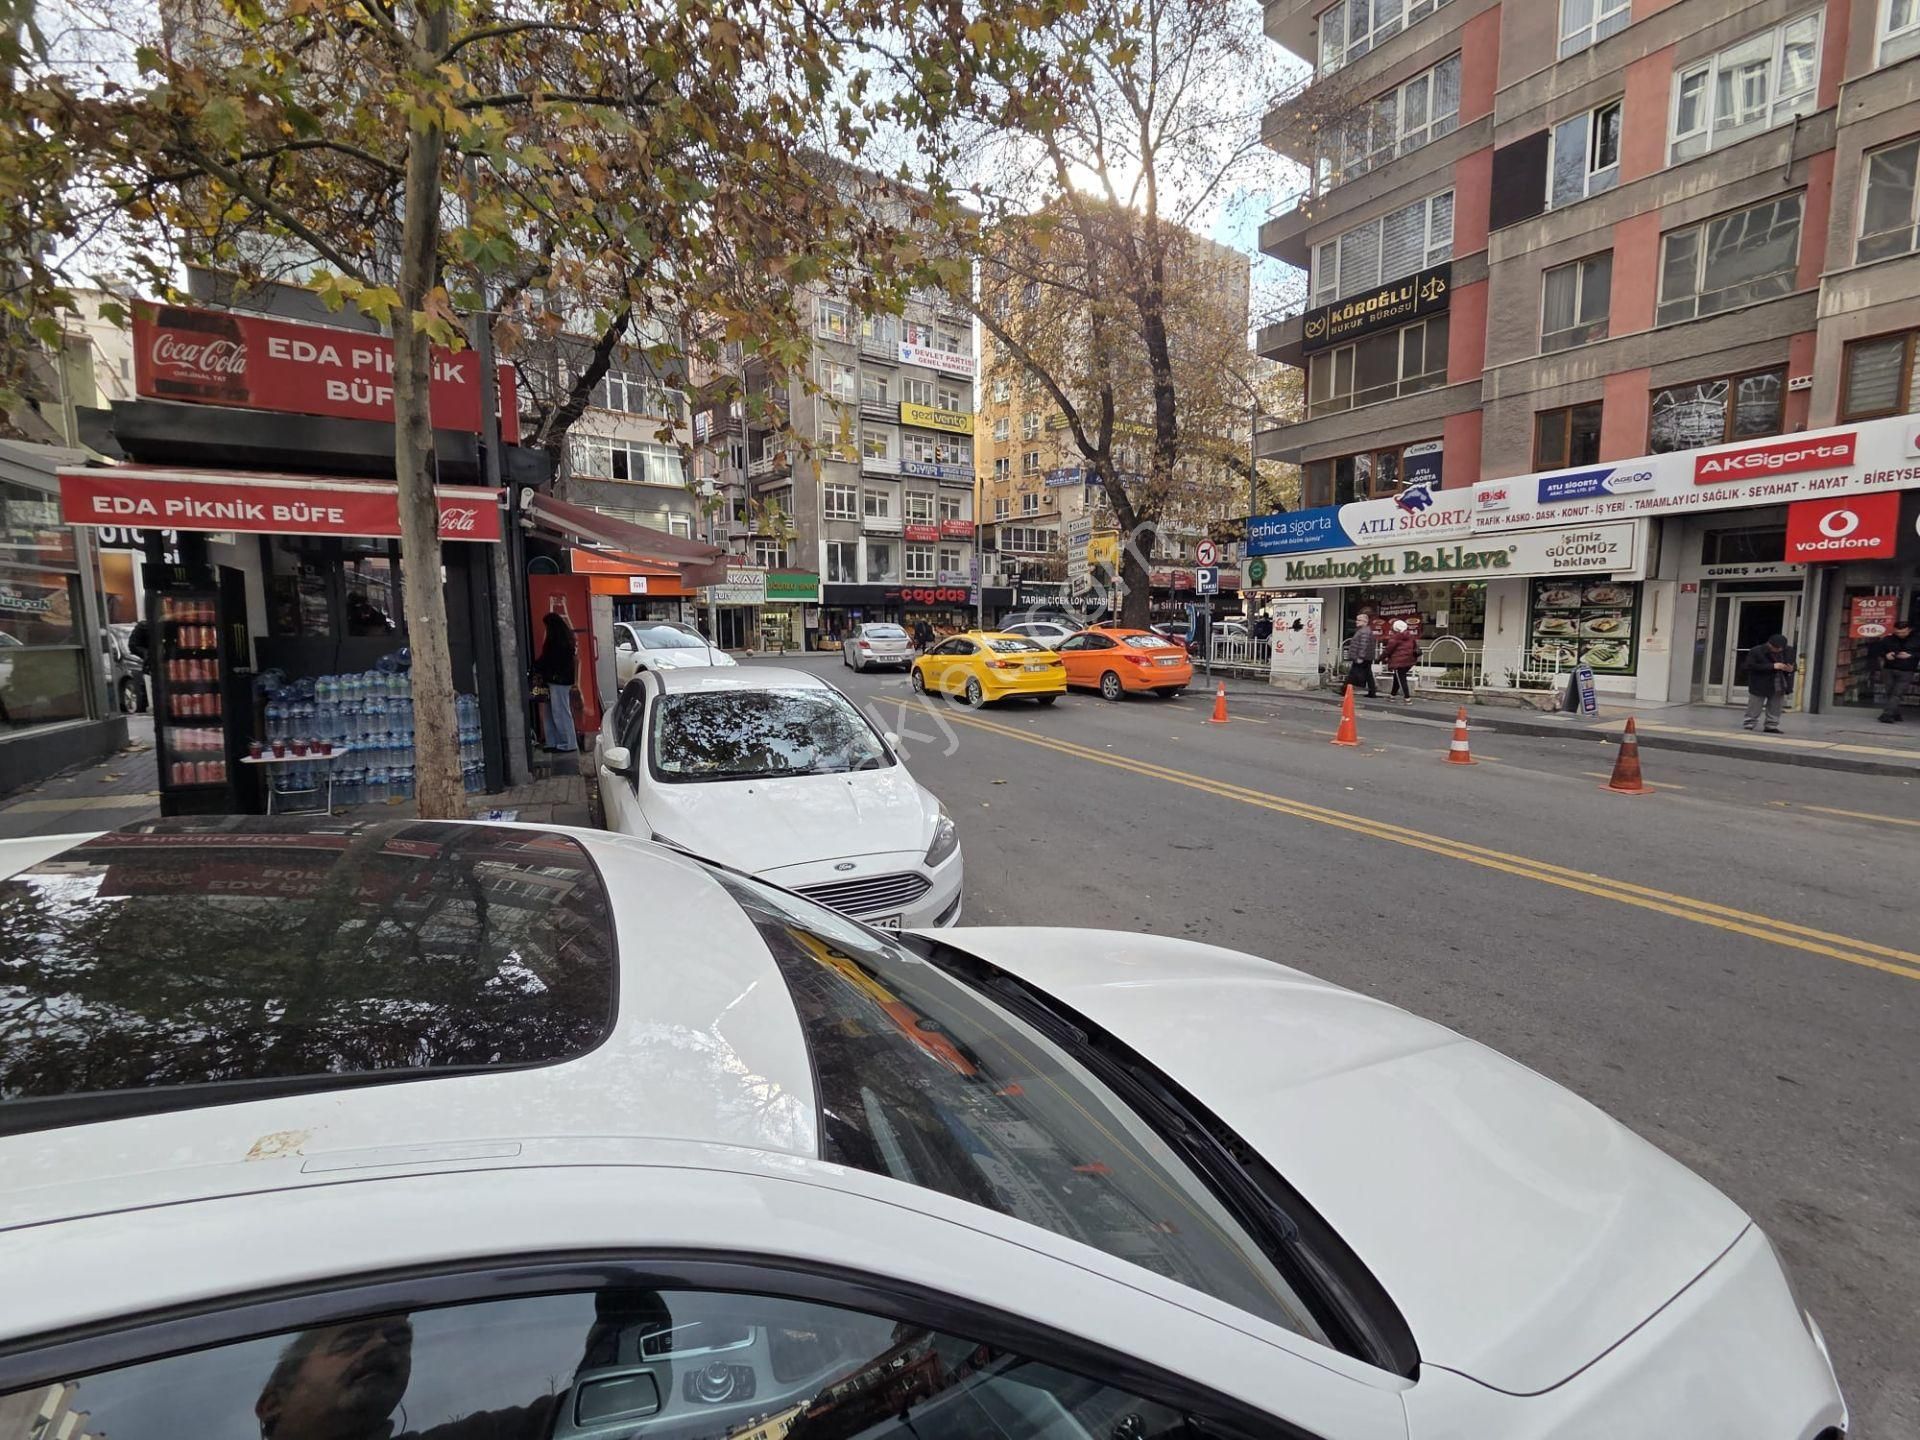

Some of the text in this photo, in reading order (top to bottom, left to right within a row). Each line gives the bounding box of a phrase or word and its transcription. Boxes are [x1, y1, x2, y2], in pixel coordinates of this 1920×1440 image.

[1331, 285, 1412, 323] KÖROĞLU
[1331, 302, 1412, 335] HUKUK BÜROSU
[152, 333, 247, 375] Coca-Cola
[268, 337, 466, 384] EDA PİKİK
[914, 348, 944, 360] DEVLET
[918, 357, 941, 367] GENEL
[326, 377, 395, 406] BÜF
[1700, 444, 1850, 473] AKSigorta
[1547, 479, 1598, 492] ATLI SİGORTA
[93, 496, 345, 524] EDA PİKNİK BÜFE
[1476, 515, 1501, 527] TRAFİK
[1505, 512, 1530, 523] KASKO
[1535, 510, 1556, 520] DASK
[1562, 506, 1590, 518] KONUT
[1595, 503, 1604, 515] İŞ
[1605, 501, 1626, 513] YERİ
[1635, 493, 1700, 510] TAMAMLAYICI
[1702, 488, 1740, 502] SAĞLIK
[1748, 482, 1799, 497] SEYAHAT
[1808, 476, 1849, 491] HAYAT
[1251, 515, 1332, 538] ethica sigorta
[1358, 519, 1395, 535] ATLI
[1546, 542, 1617, 556] GÜCÜMÜZ
[1795, 537, 1881, 551] vodafone
[1285, 553, 1395, 582] Musluoğlu
[1553, 556, 1607, 568] baklava
[1708, 567, 1749, 576] GÜNEŞ
[1198, 569, 1212, 593] P
